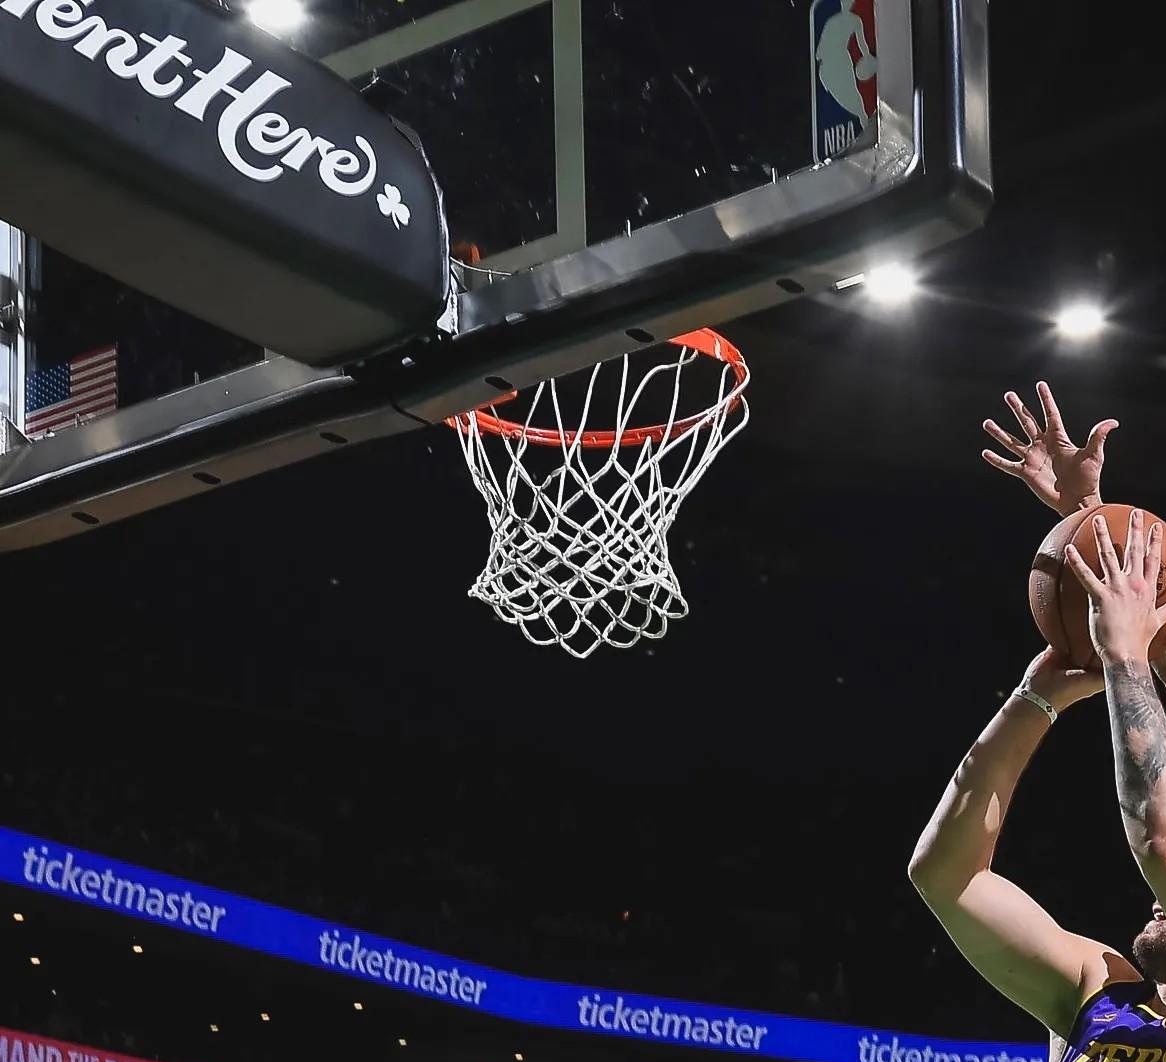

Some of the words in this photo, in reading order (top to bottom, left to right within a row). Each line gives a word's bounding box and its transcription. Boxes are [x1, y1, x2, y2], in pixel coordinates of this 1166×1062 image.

[824, 119, 857, 157] NBA
[24, 847, 226, 933] ticketmaster
[320, 929, 487, 1004] ticketmaster
[578, 994, 767, 1050] ticketmaster
